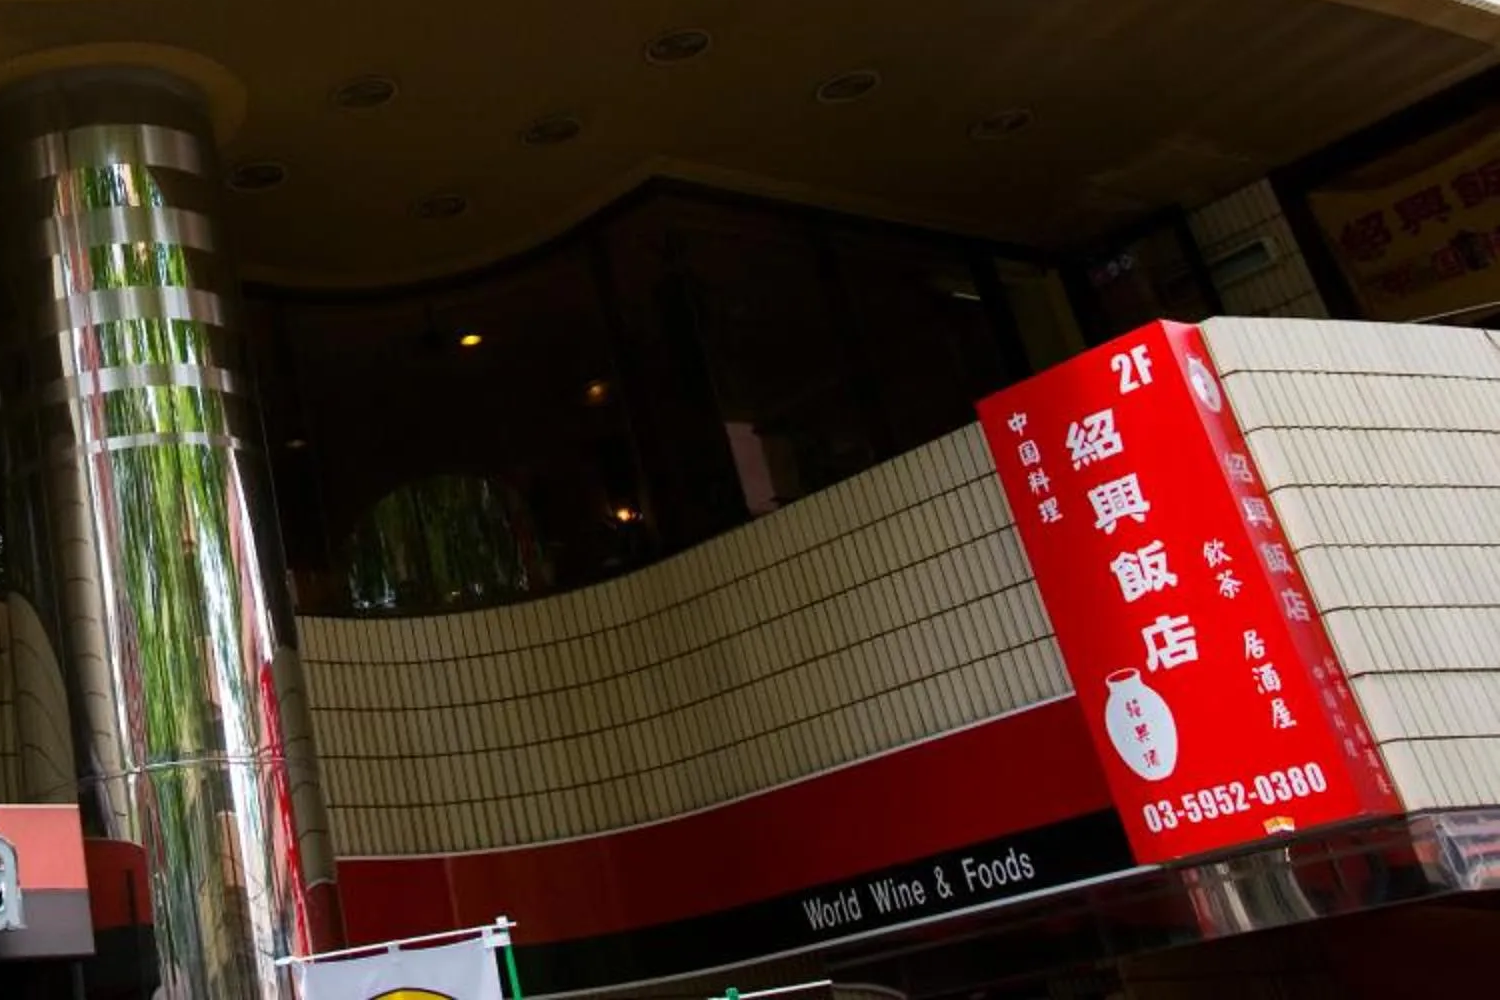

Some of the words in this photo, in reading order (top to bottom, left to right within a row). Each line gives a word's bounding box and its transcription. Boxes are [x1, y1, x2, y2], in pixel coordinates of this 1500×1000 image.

[1110, 344, 1154, 397] 2F
[1006, 411, 1064, 524] 中国料理
[1064, 408, 1199, 674] 紹興飯店
[1202, 538, 1244, 600] 飲茶
[1243, 629, 1298, 730] 居酒屋
[1142, 761, 1329, 834] 03-5952-0380
[802, 888, 863, 931] World
[868, 878, 927, 914] Wine
[933, 865, 954, 899] &
[961, 847, 1036, 893] Foods
